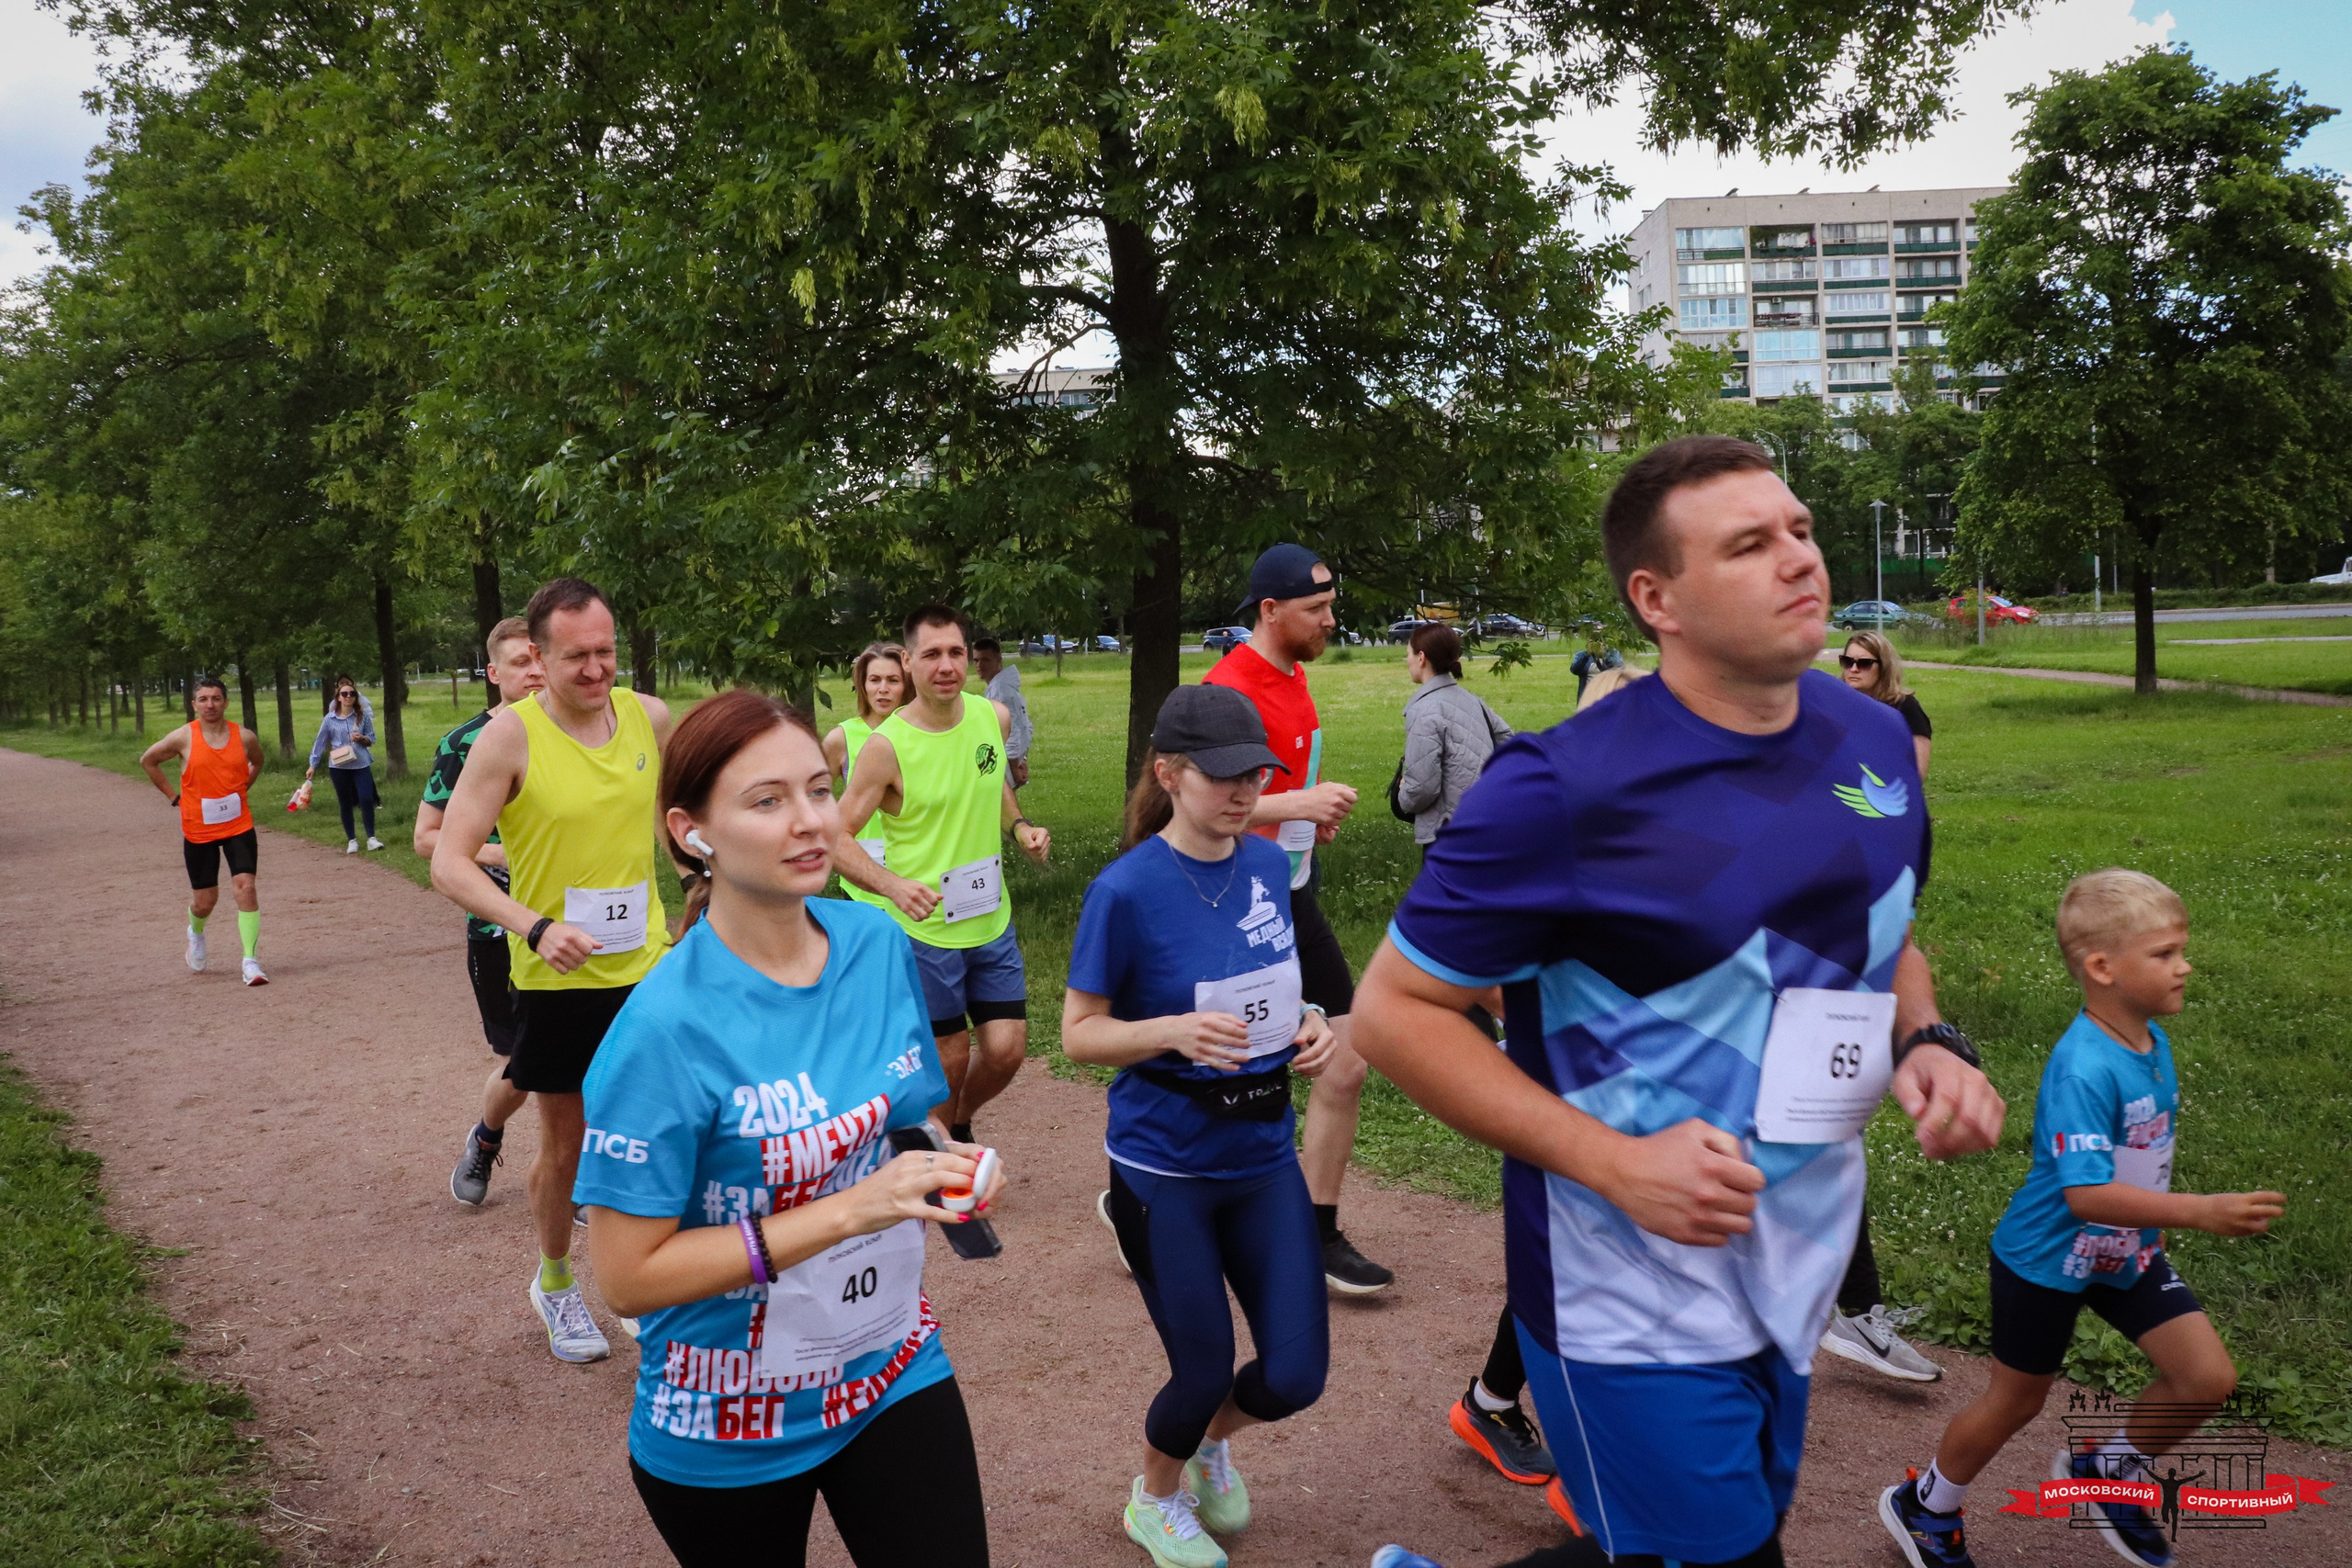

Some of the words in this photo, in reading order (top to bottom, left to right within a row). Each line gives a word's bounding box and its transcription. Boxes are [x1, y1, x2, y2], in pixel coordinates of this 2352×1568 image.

[971, 877, 985, 890] 43
[605, 903, 628, 921] 12
[1244, 998, 1269, 1024] 55
[1830, 1041, 1862, 1079] 69
[734, 1072, 830, 1139] 2024
[582, 1127, 649, 1165] ПСБ
[761, 1093, 890, 1186] #МЕЧТА
[842, 1266, 877, 1304] 40
[650, 1382, 785, 1440] #ЗАБЕГ
